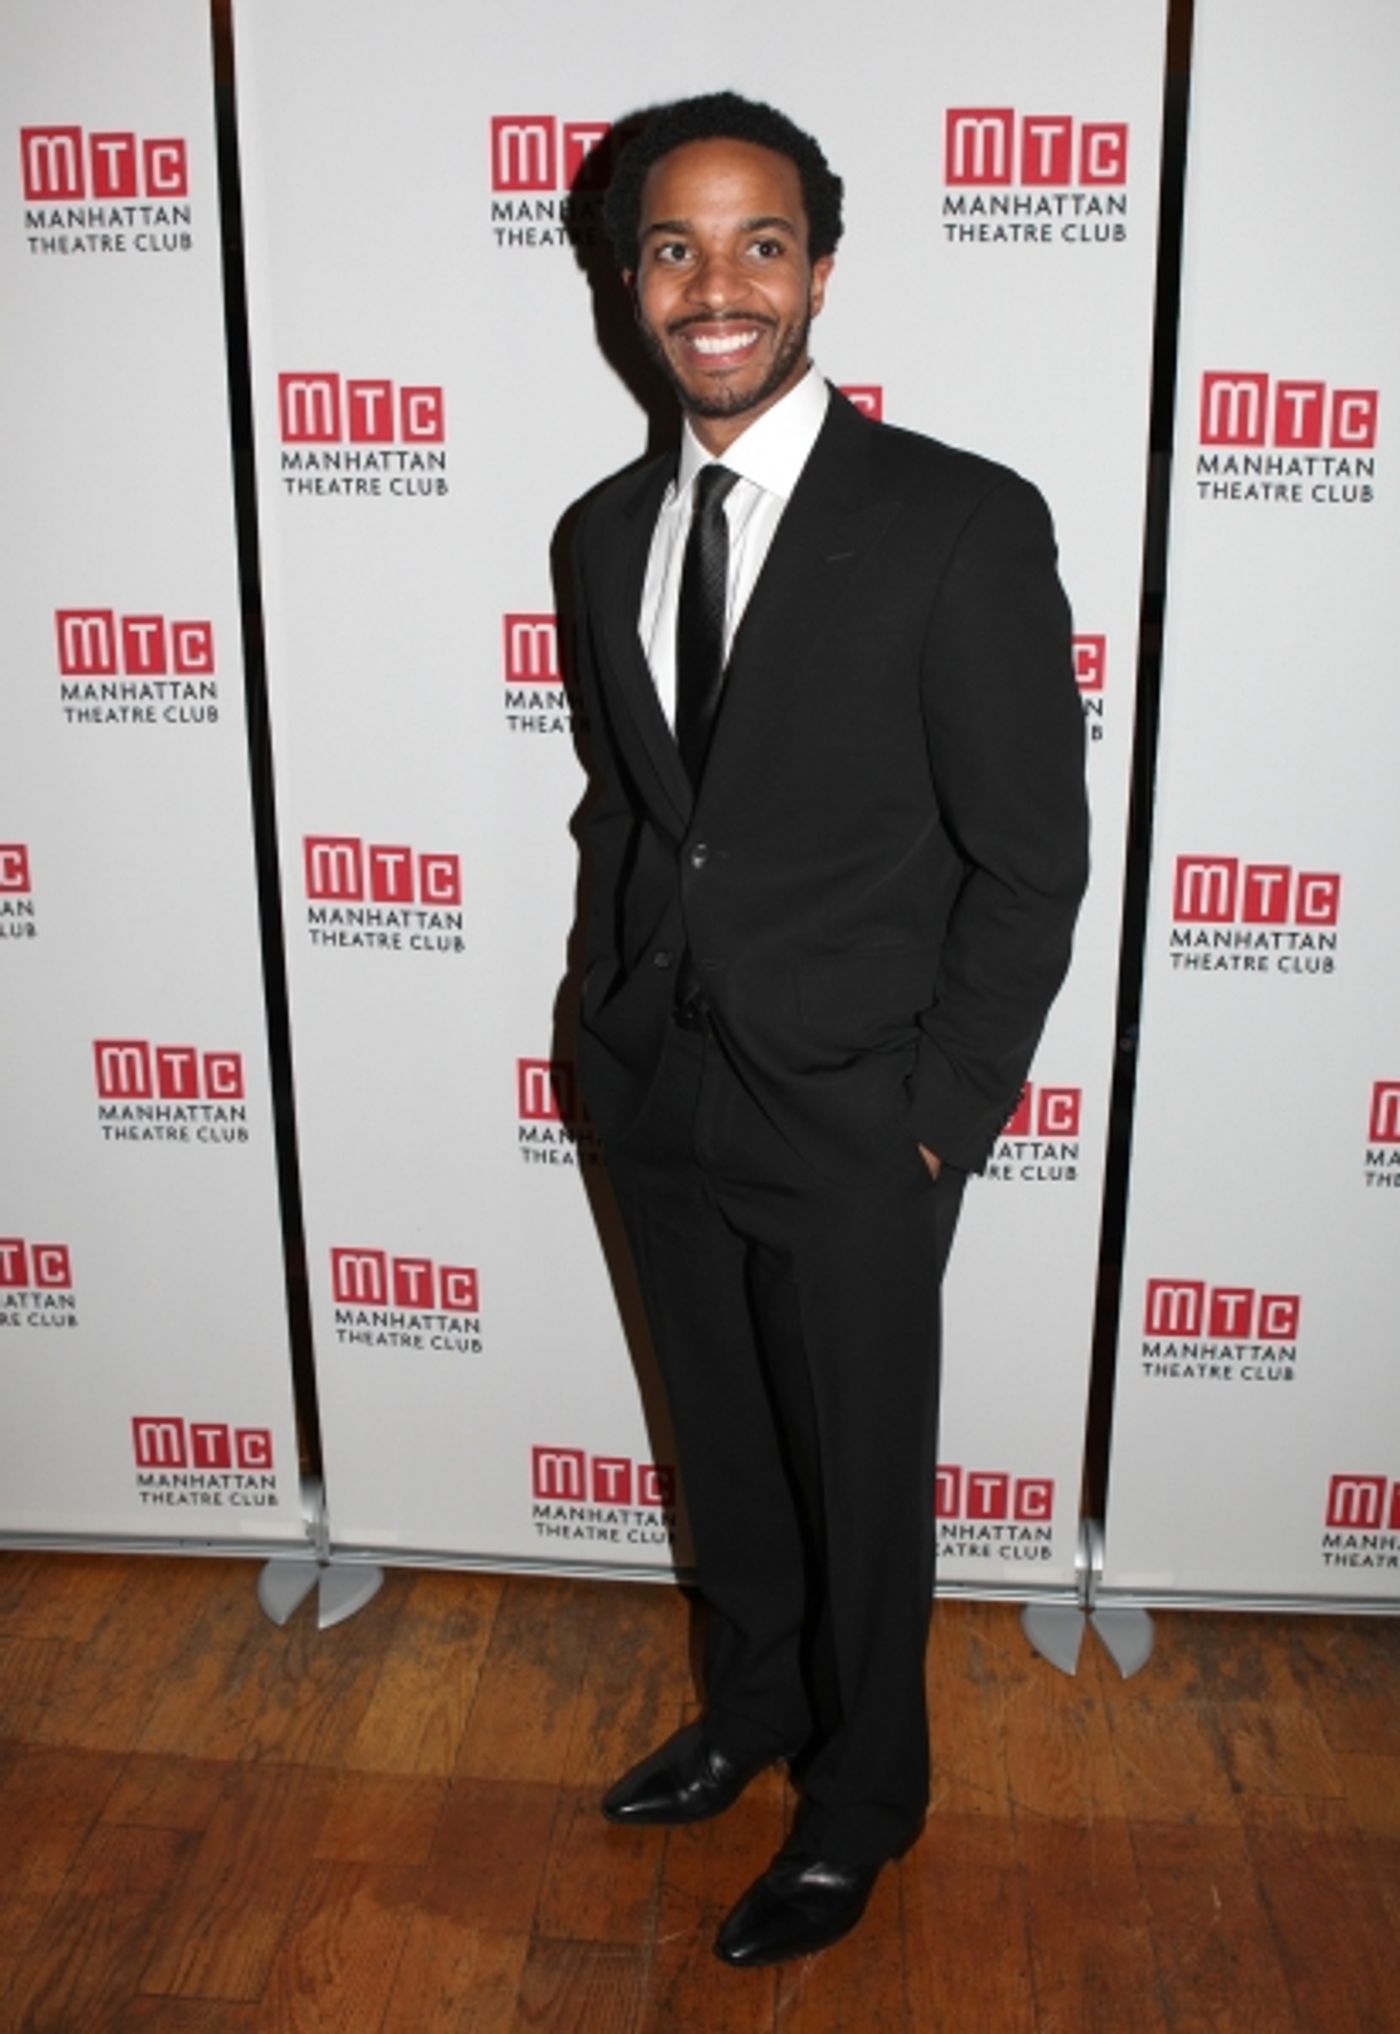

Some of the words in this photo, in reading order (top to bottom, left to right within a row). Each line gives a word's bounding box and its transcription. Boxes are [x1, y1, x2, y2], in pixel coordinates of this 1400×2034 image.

[499, 123, 604, 184] MT
[952, 117, 1120, 178] MTC
[27, 135, 182, 195] MTC
[942, 193, 1127, 217] MANHATTAN
[24, 205, 191, 229] MANHATTAN
[26, 233, 127, 255] THEATRE
[134, 232, 192, 253] CLUB
[493, 227, 566, 247] THEAT
[943, 223, 1053, 243] THEATRE
[1060, 223, 1127, 243] CLUB
[285, 380, 437, 437] MTC
[1207, 380, 1370, 442] MTC
[280, 450, 446, 472] MANHATTAN
[1196, 453, 1375, 478] MANHATTAN
[283, 477, 382, 497] THEATRE
[389, 477, 449, 497] CLUB
[1196, 480, 1303, 503] THEATRE
[1311, 484, 1375, 504] CLUB
[64, 617, 208, 668] MTC
[60, 681, 218, 701] MANHATTAN
[62, 705, 157, 724] THEATRE
[162, 705, 219, 724] CLUB
[506, 714, 564, 734] THEA
[310, 846, 455, 898] MTC
[1179, 864, 1331, 918] MTC
[0, 921, 38, 939] LUB
[307, 906, 463, 931] MANHATTAN
[308, 928, 402, 951] THEATRE
[409, 934, 466, 954] CLUB
[1169, 928, 1338, 951] MANHATTAN
[1170, 952, 1269, 972] THEATRE
[1277, 955, 1336, 975] CLUB
[100, 1047, 237, 1094] MTC
[98, 1104, 246, 1123] MANHATTAN
[101, 1125, 188, 1142] THEATRE
[196, 1126, 249, 1143] CLUB
[520, 1147, 575, 1165] THEA
[997, 1141, 1080, 1161] ATTAN
[1019, 1165, 1079, 1182] CLUB
[0, 1244, 66, 1283] TC
[338, 1254, 470, 1304] MTC
[3, 1291, 76, 1310] ATTAN
[1151, 1287, 1291, 1335] MTC
[27, 1312, 79, 1328] CLUB
[334, 1308, 480, 1334] MANHATTAN
[336, 1328, 423, 1350] THEATRE
[430, 1335, 483, 1354] CLUB
[1141, 1341, 1297, 1362] MANHATTAN
[1142, 1362, 1232, 1381] THEATRE
[1240, 1365, 1295, 1382] CLUB
[138, 1423, 266, 1464] MTC
[136, 1473, 276, 1489] MANHATTAN
[139, 1491, 222, 1506] THEATRE
[229, 1491, 279, 1507] CLUB
[535, 1522, 620, 1543] THEATRE
[941, 1523, 1053, 1541] NHATTAN
[936, 1542, 992, 1558] ATRE
[998, 1545, 1053, 1561] CLUB
[1322, 1552, 1400, 1568] THEATR
